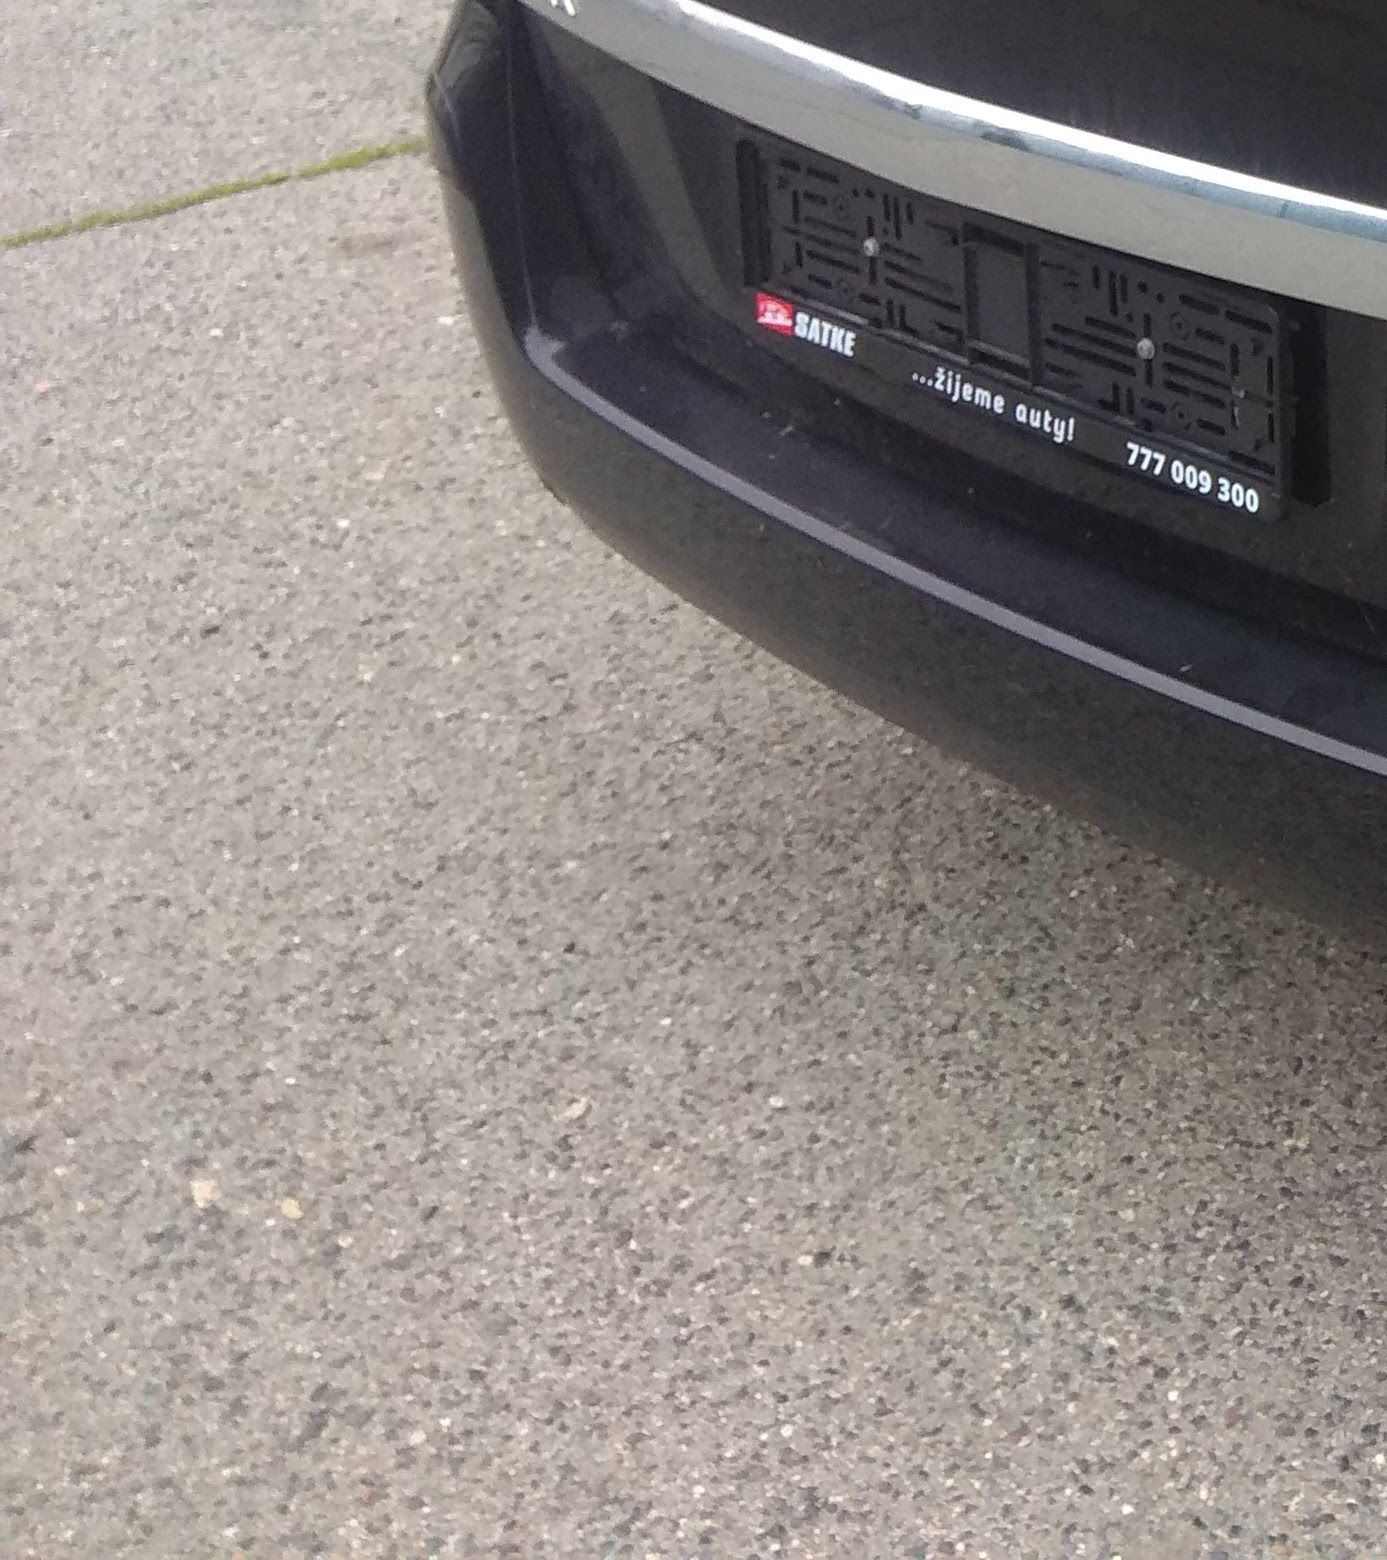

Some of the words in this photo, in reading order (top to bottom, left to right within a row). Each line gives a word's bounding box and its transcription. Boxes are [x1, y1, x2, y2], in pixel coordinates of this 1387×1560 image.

[794, 311, 857, 357] SATKE
[1015, 403, 1075, 444] auty!
[1126, 441, 1166, 476] 777
[1171, 459, 1212, 494] 009
[1217, 476, 1259, 513] 300
